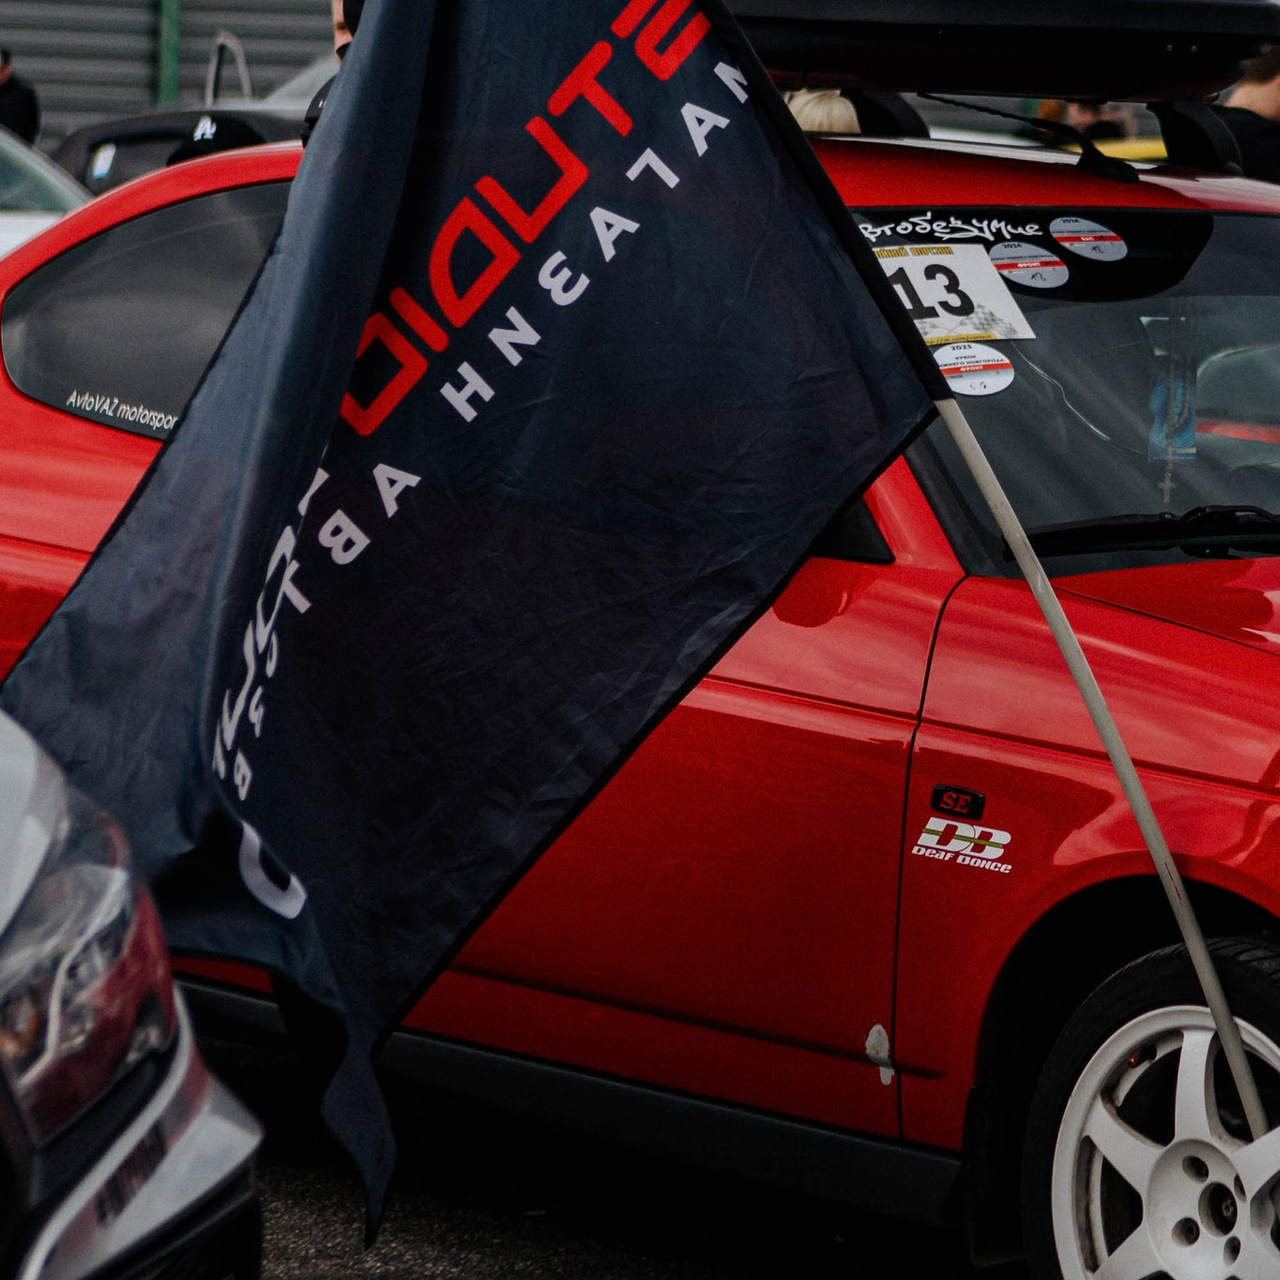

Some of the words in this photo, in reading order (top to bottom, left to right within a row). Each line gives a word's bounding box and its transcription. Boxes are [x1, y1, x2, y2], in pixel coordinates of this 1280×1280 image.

[858, 211, 1044, 242] втобезумие
[66, 389, 119, 417] AvtoVAZ
[116, 403, 178, 431] motorspor
[940, 791, 972, 813] SE
[917, 816, 1012, 860] DB
